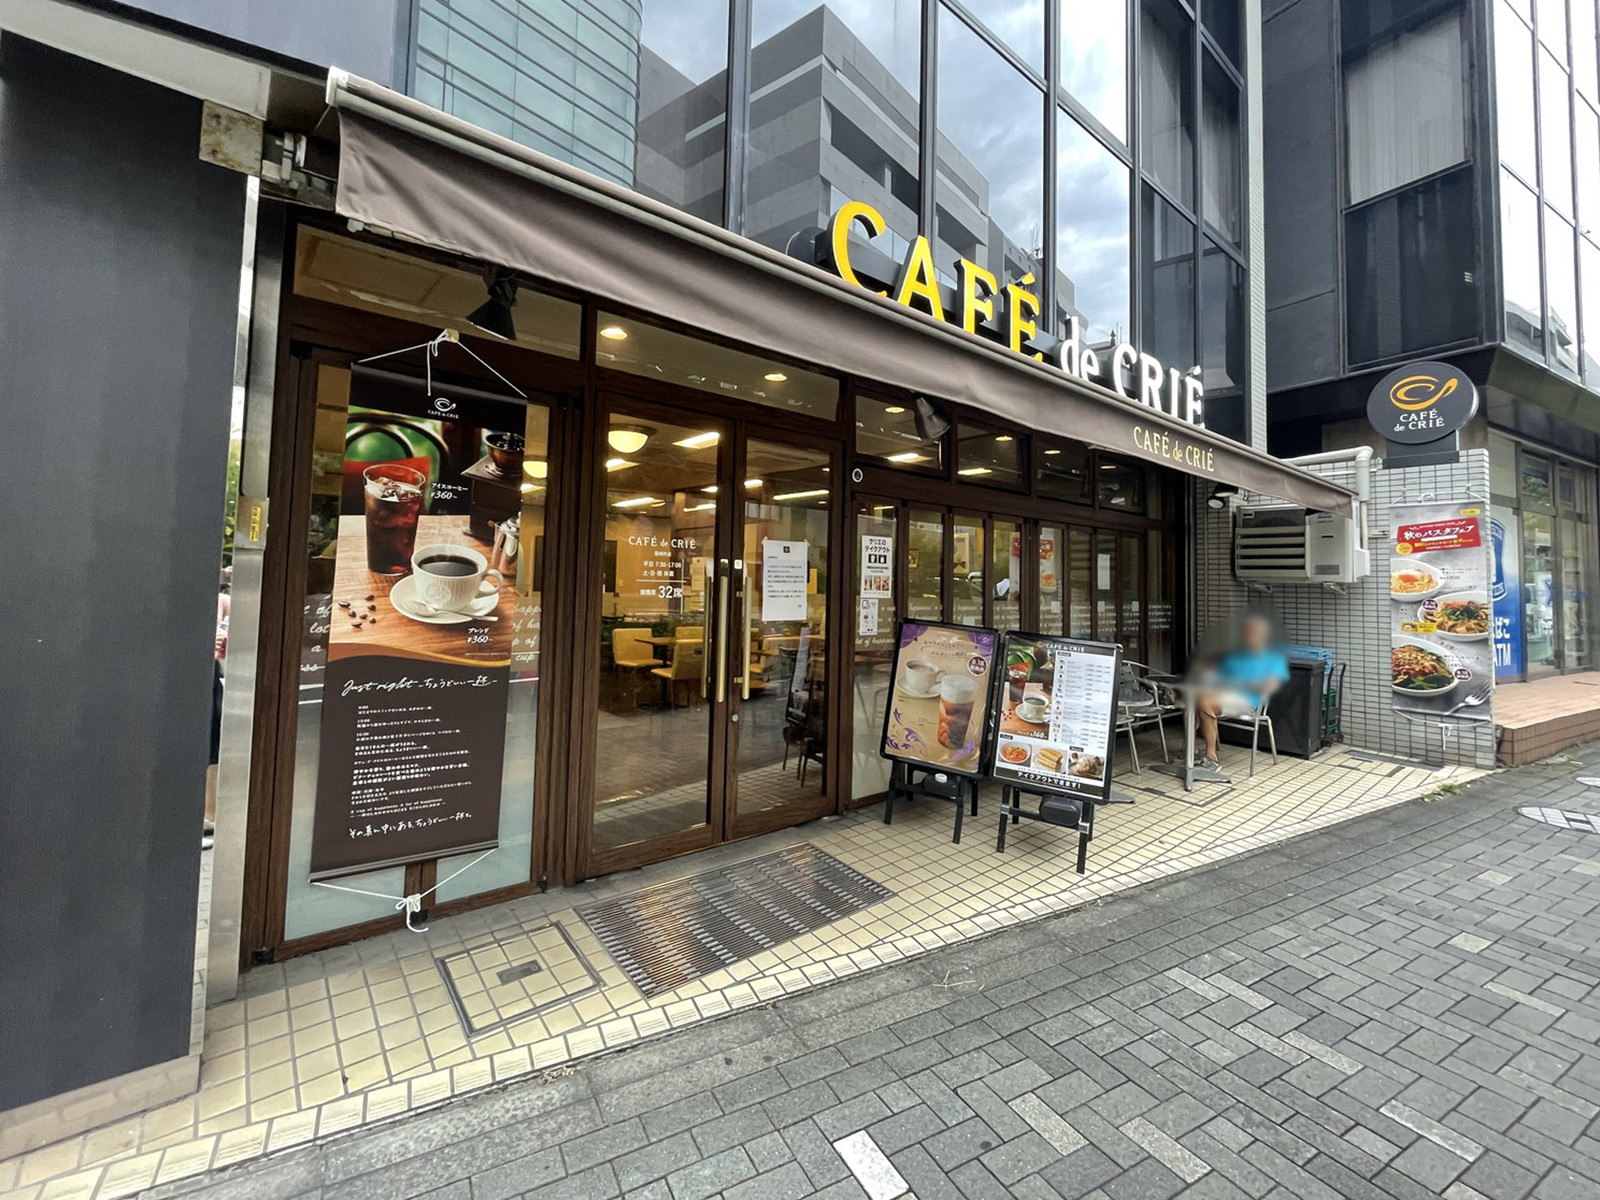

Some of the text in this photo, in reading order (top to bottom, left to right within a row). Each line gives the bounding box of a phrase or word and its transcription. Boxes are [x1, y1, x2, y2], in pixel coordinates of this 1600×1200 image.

[832, 200, 1206, 429] CAFÉ de CRIÉ
[1399, 408, 1439, 423] CAFÉ
[1393, 416, 1446, 432] de CRIÉ
[1133, 426, 1215, 472] CAFÉ de CRIÉ
[431, 482, 469, 492] アイスコーヒー
[628, 535, 658, 547] CAFÉ
[670, 538, 697, 550] CRIÉ
[864, 545, 890, 553] テイクアウト
[341, 679, 378, 697] Just
[376, 677, 419, 692] right
